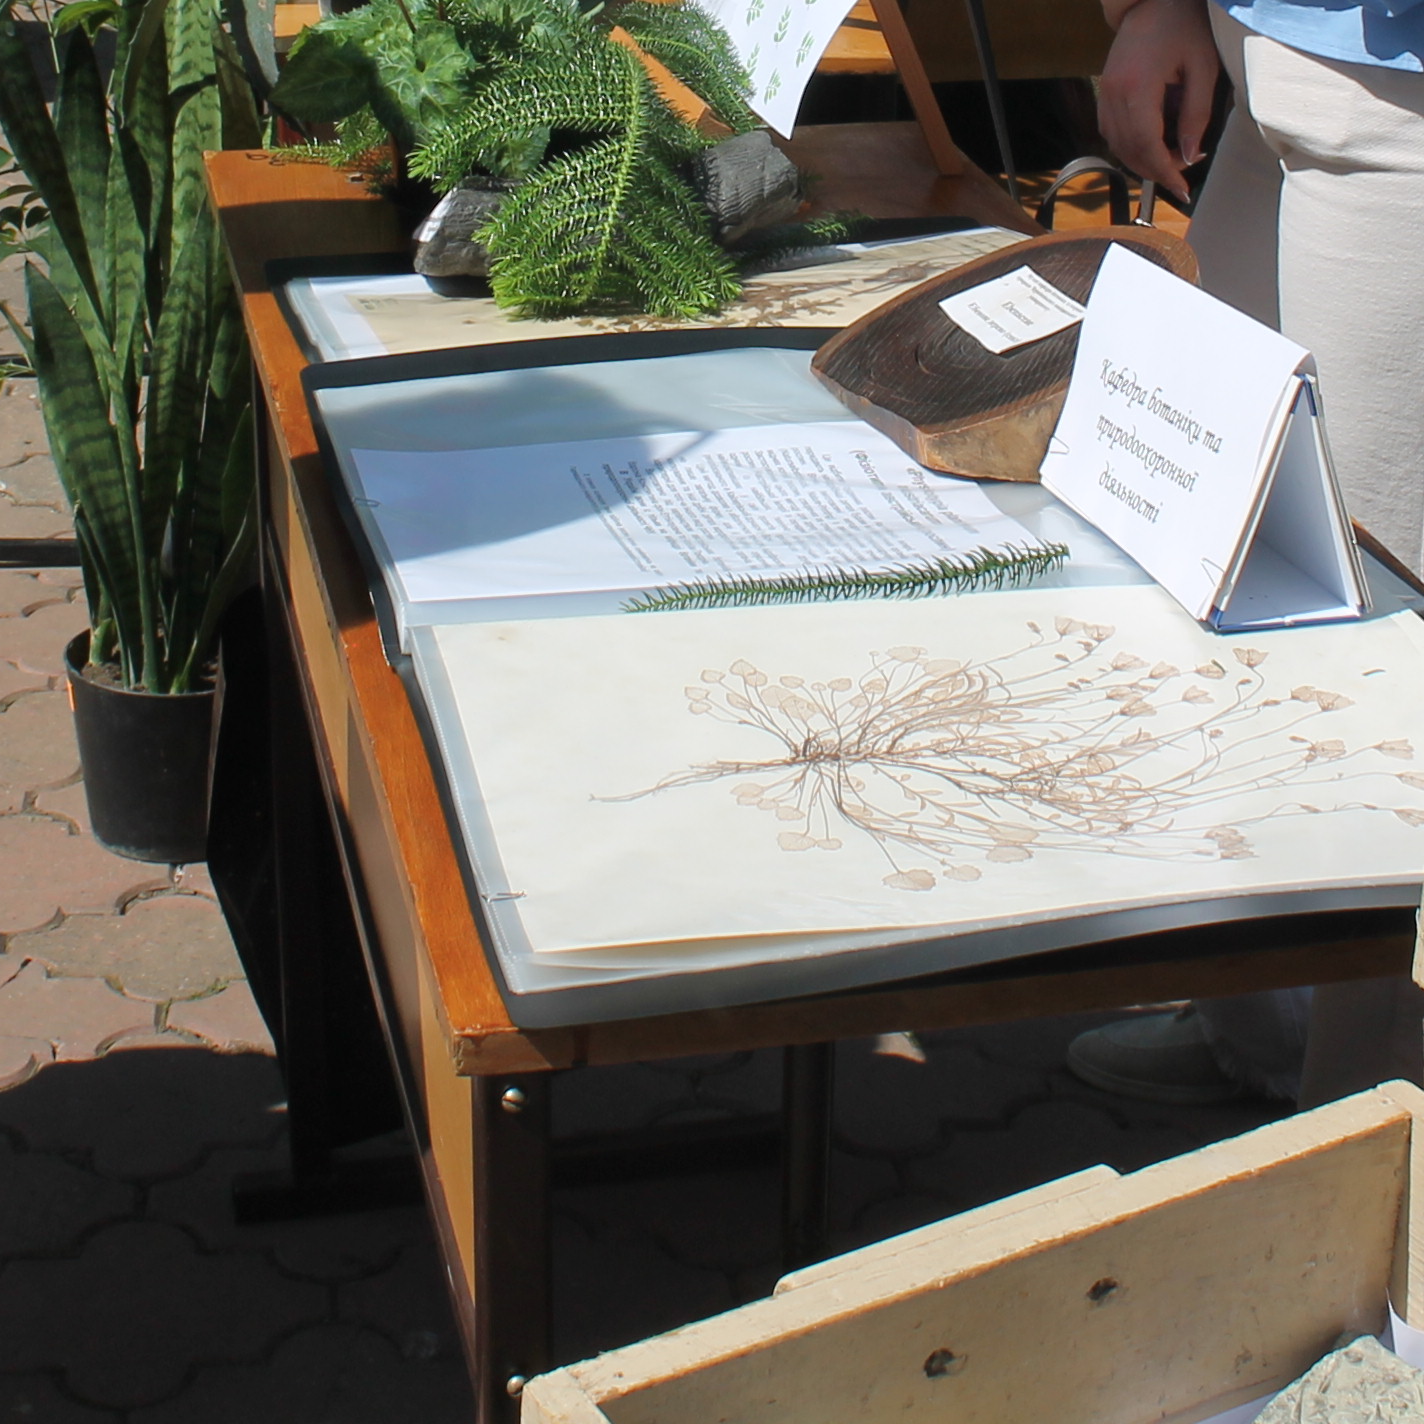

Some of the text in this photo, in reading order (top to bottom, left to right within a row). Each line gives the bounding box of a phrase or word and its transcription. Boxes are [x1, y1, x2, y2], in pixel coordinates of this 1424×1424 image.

[1100, 359, 1223, 453] Кафедра ботаніки та
[1096, 414, 1199, 493] природоохоронної
[1099, 460, 1164, 524] діяльності
